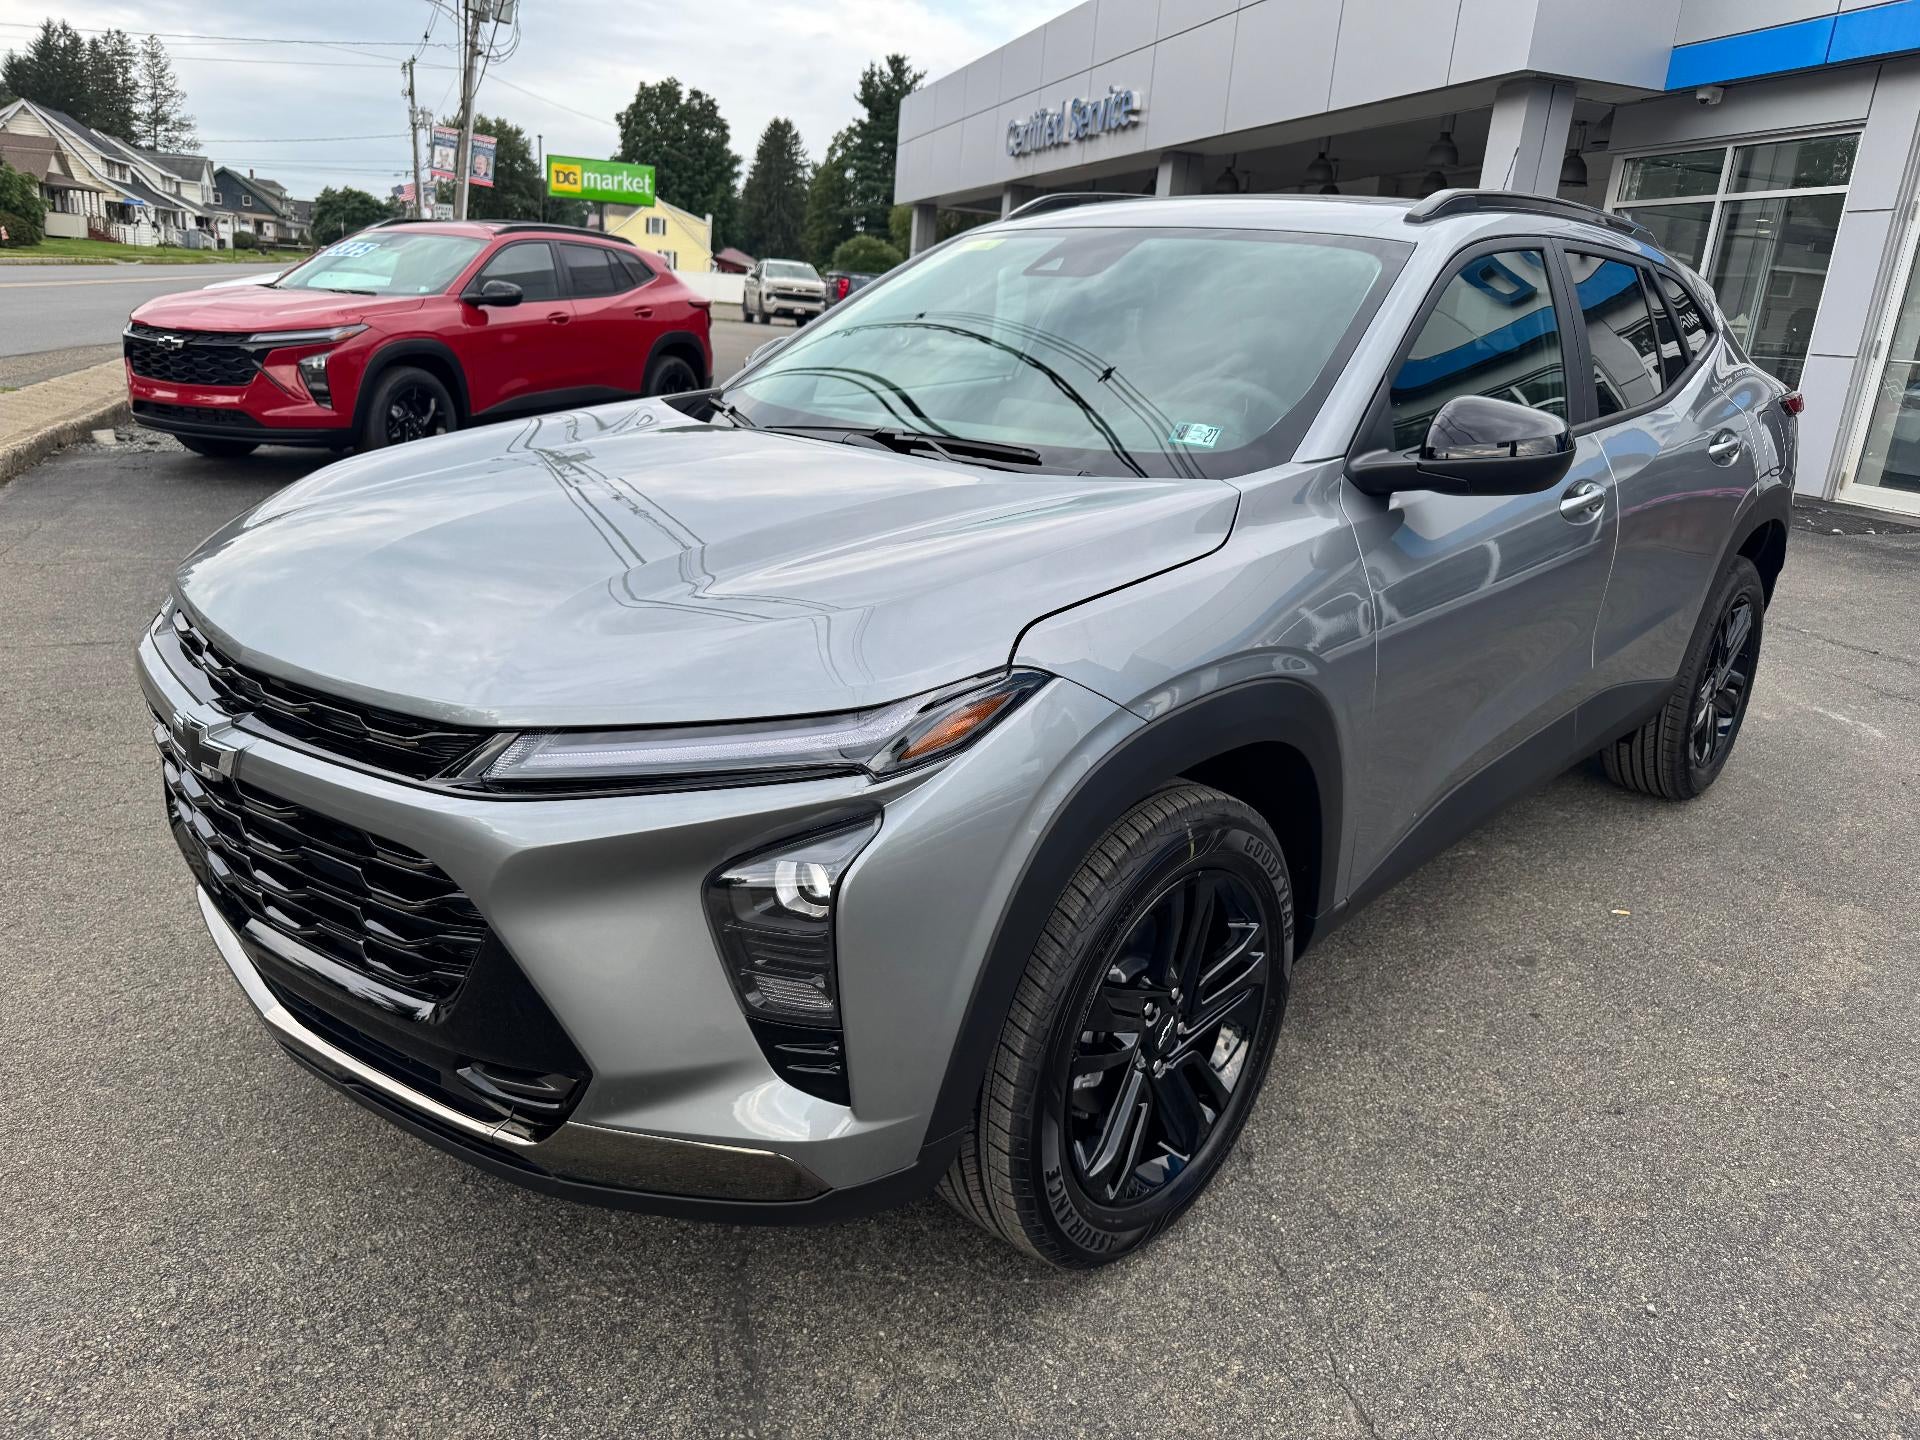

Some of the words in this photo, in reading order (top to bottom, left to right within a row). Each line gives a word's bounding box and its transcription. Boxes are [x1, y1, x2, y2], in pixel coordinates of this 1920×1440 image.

[1007, 101, 1070, 156] Certified
[1070, 86, 1140, 141] Service
[555, 169, 578, 186] DG
[583, 171, 651, 194] market
[1203, 428, 1219, 443] 27
[1043, 1165, 1118, 1252] ASSURANCE
